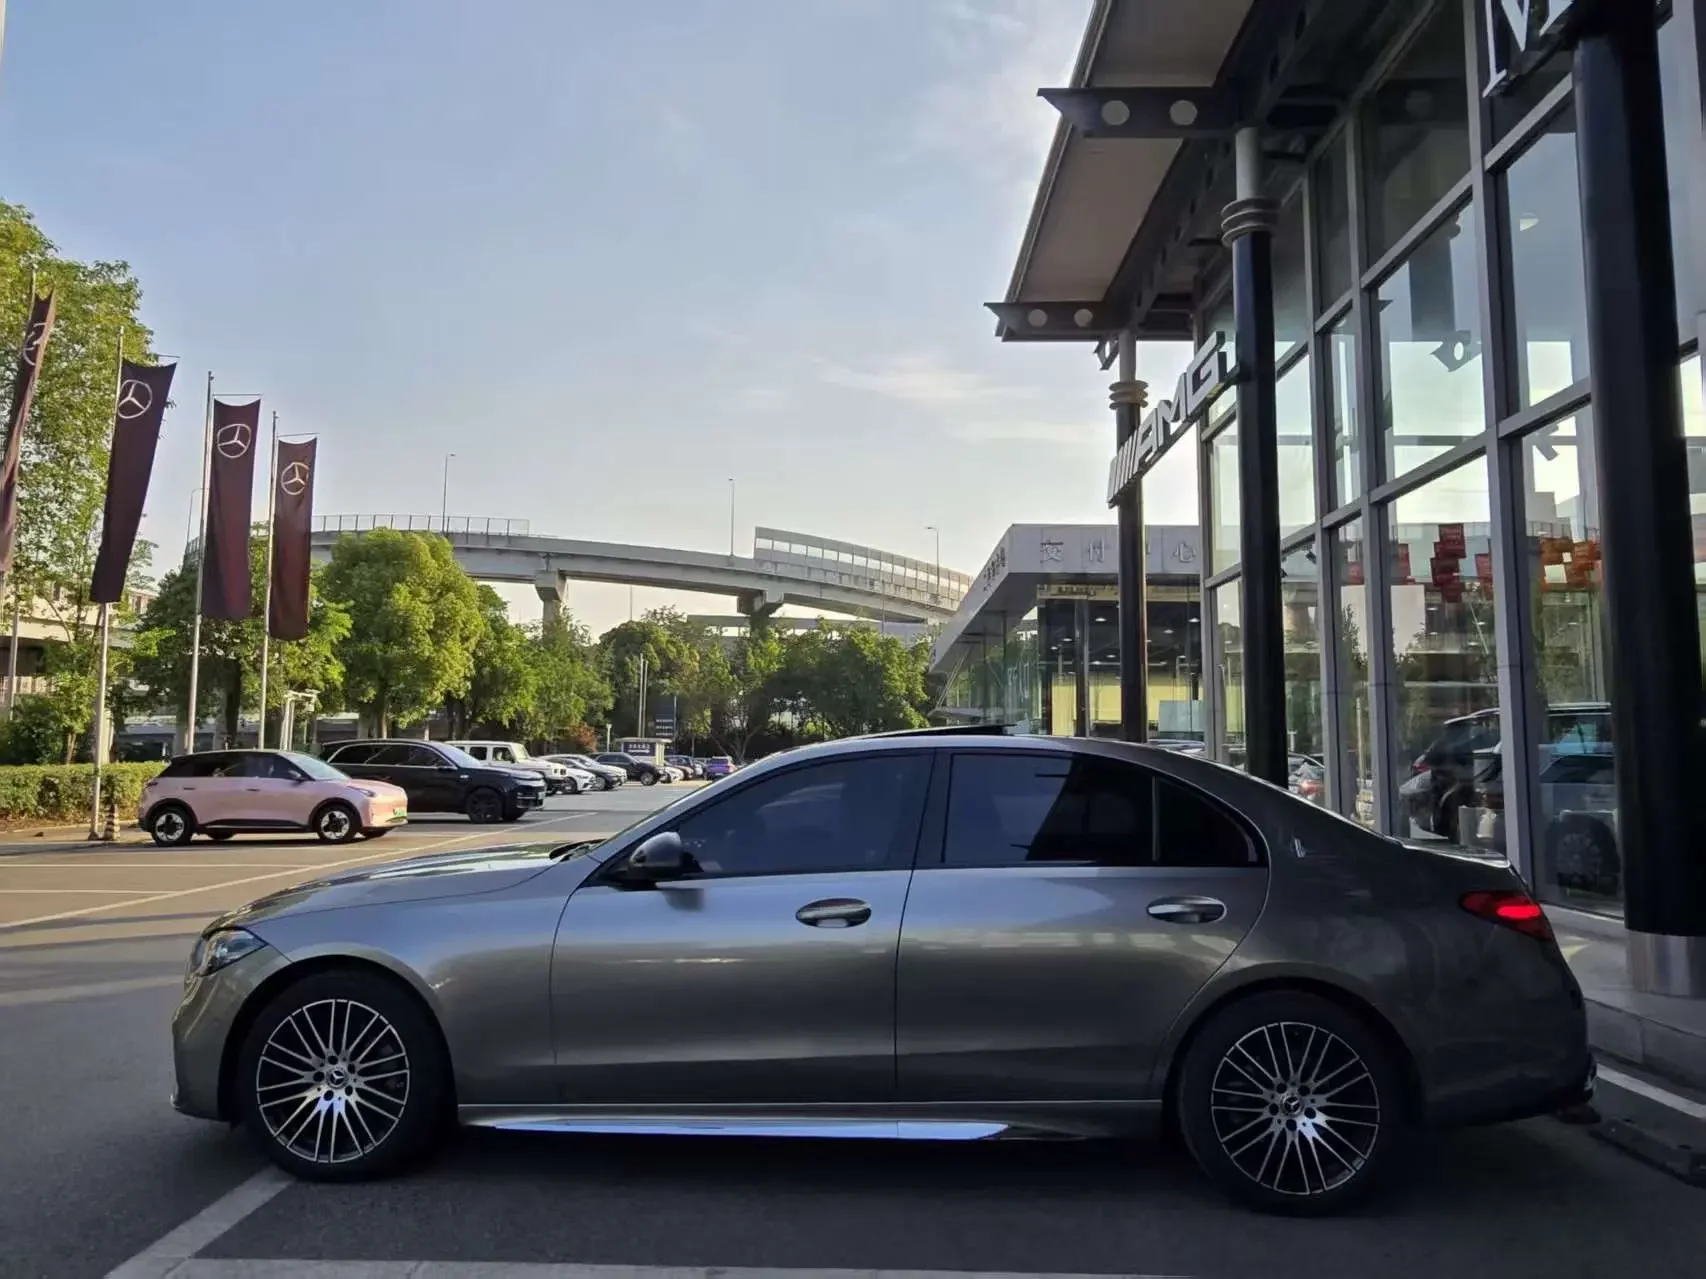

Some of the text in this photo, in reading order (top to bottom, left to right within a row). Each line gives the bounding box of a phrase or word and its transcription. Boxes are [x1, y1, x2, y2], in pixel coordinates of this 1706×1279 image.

[1130, 331, 1227, 476] AMG
[1040, 539, 1197, 564] 交付心
